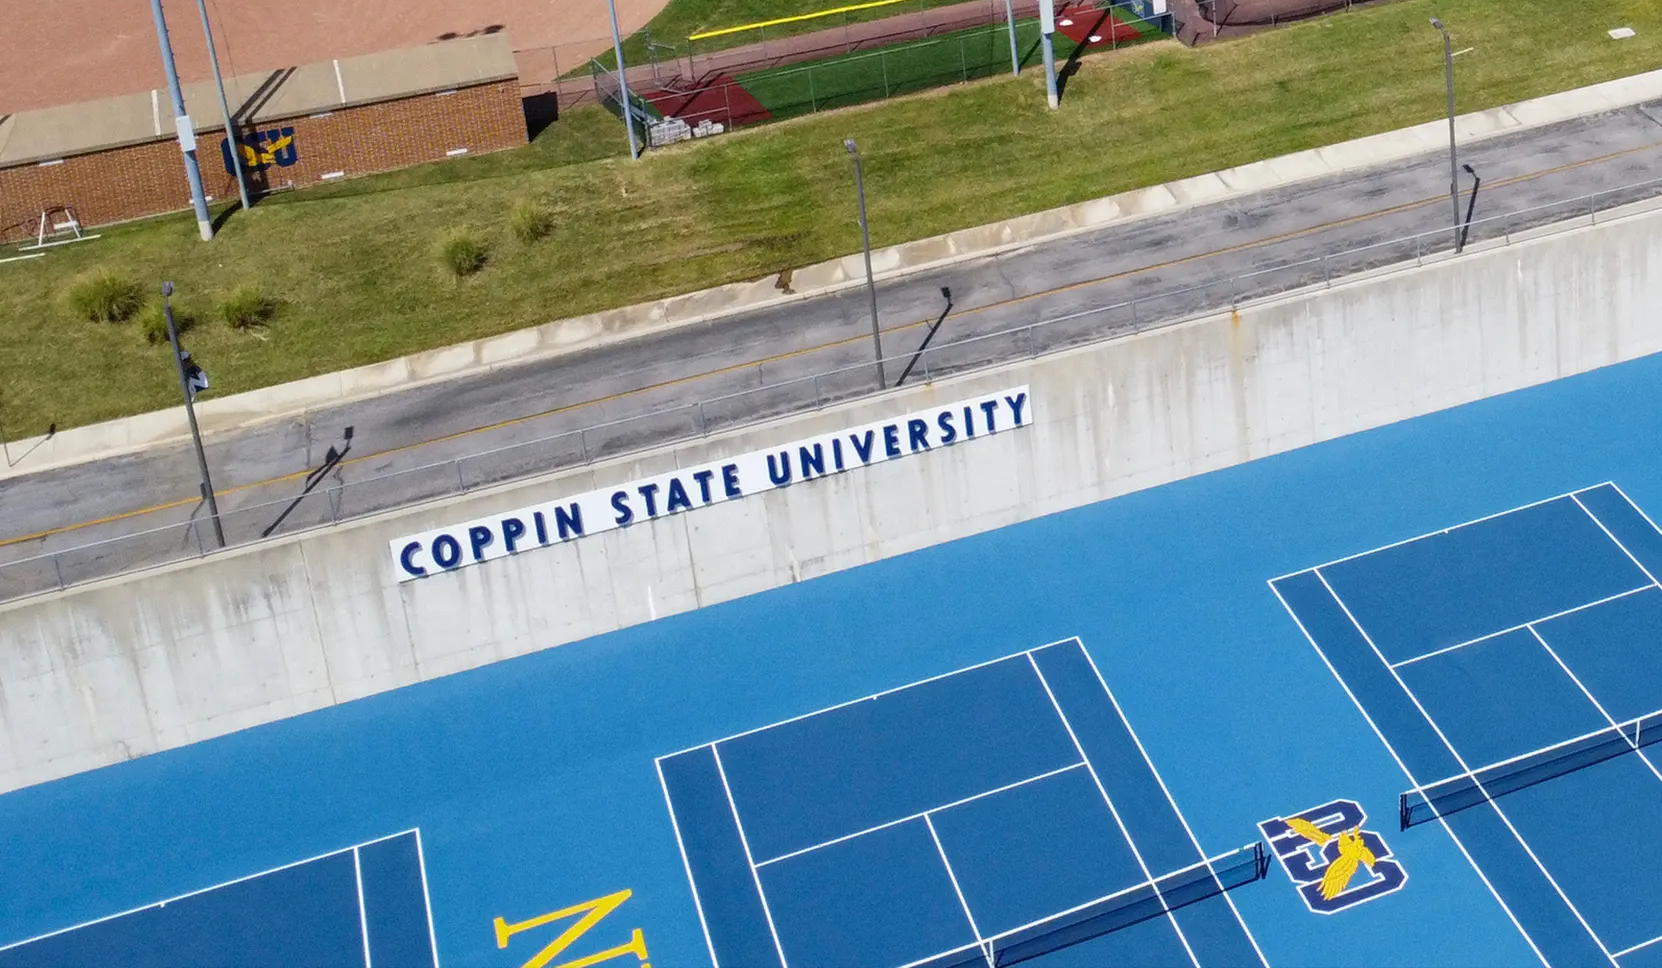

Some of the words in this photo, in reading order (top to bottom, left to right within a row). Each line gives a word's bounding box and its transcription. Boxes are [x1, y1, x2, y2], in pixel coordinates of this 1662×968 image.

[400, 502, 585, 577] COPPIN
[611, 463, 742, 526] STATE
[766, 393, 1027, 485] UNIVERSITY
